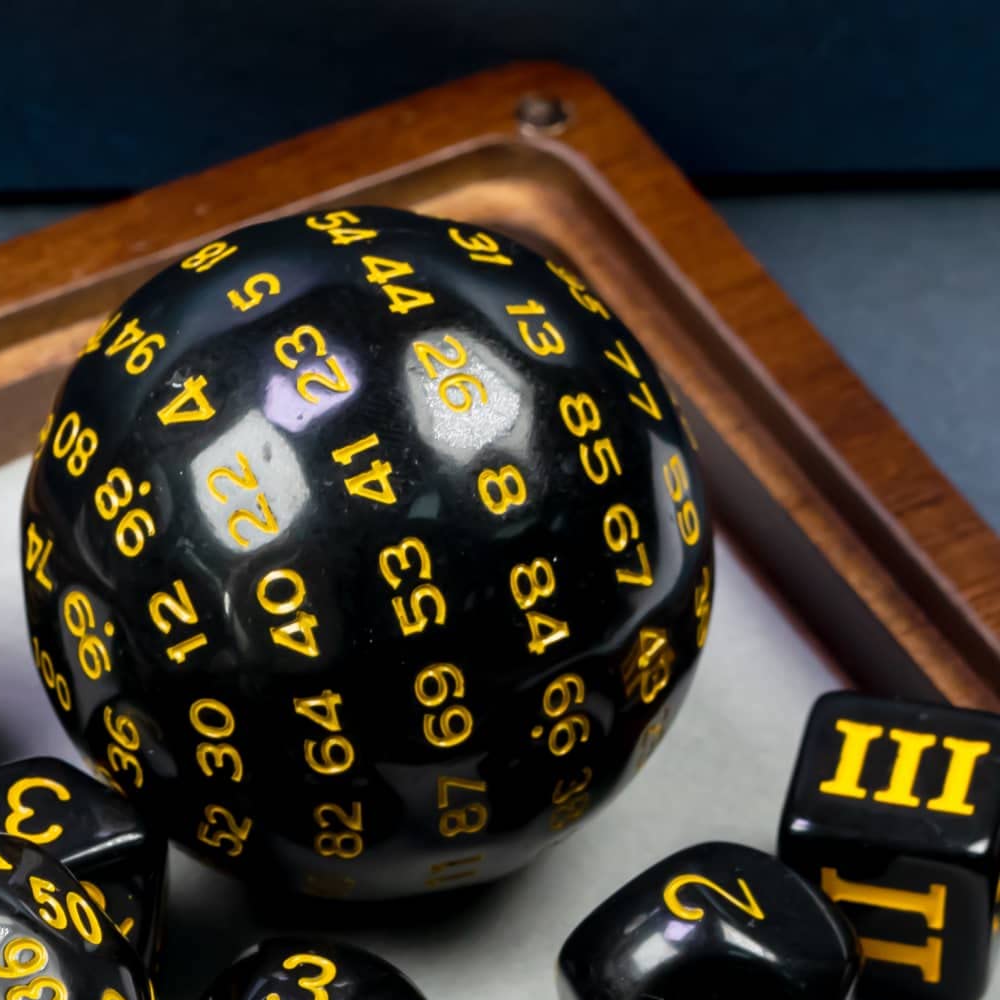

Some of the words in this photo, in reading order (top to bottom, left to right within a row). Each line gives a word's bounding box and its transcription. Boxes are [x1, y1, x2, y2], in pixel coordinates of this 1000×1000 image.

[306, 210, 378, 246] 54
[448, 227, 513, 266] 31
[227, 272, 280, 312] 5
[360, 254, 435, 315] 44
[104, 318, 166, 375] 94
[505, 298, 567, 357] 13
[274, 325, 354, 405] 23
[411, 335, 488, 413] 26
[604, 340, 663, 421] 77
[156, 374, 217, 427] 4
[52, 411, 99, 477] 80
[331, 432, 397, 506] 41
[559, 392, 622, 485] 85
[207, 451, 279, 548] 22
[476, 463, 528, 516] 8
[603, 503, 655, 588] 67
[148, 579, 208, 664] 12
[256, 567, 320, 658] 40
[379, 537, 447, 636] 53
[510, 558, 570, 655] 84
[189, 698, 243, 782] 30
[293, 689, 355, 775] 64
[818, 718, 992, 816] III
[4, 776, 71, 846] 3
[197, 804, 252, 857] 52
[313, 802, 364, 858] 82
[436, 775, 487, 837] 87
[29, 875, 106, 945] 50
[662, 873, 765, 921] 2
